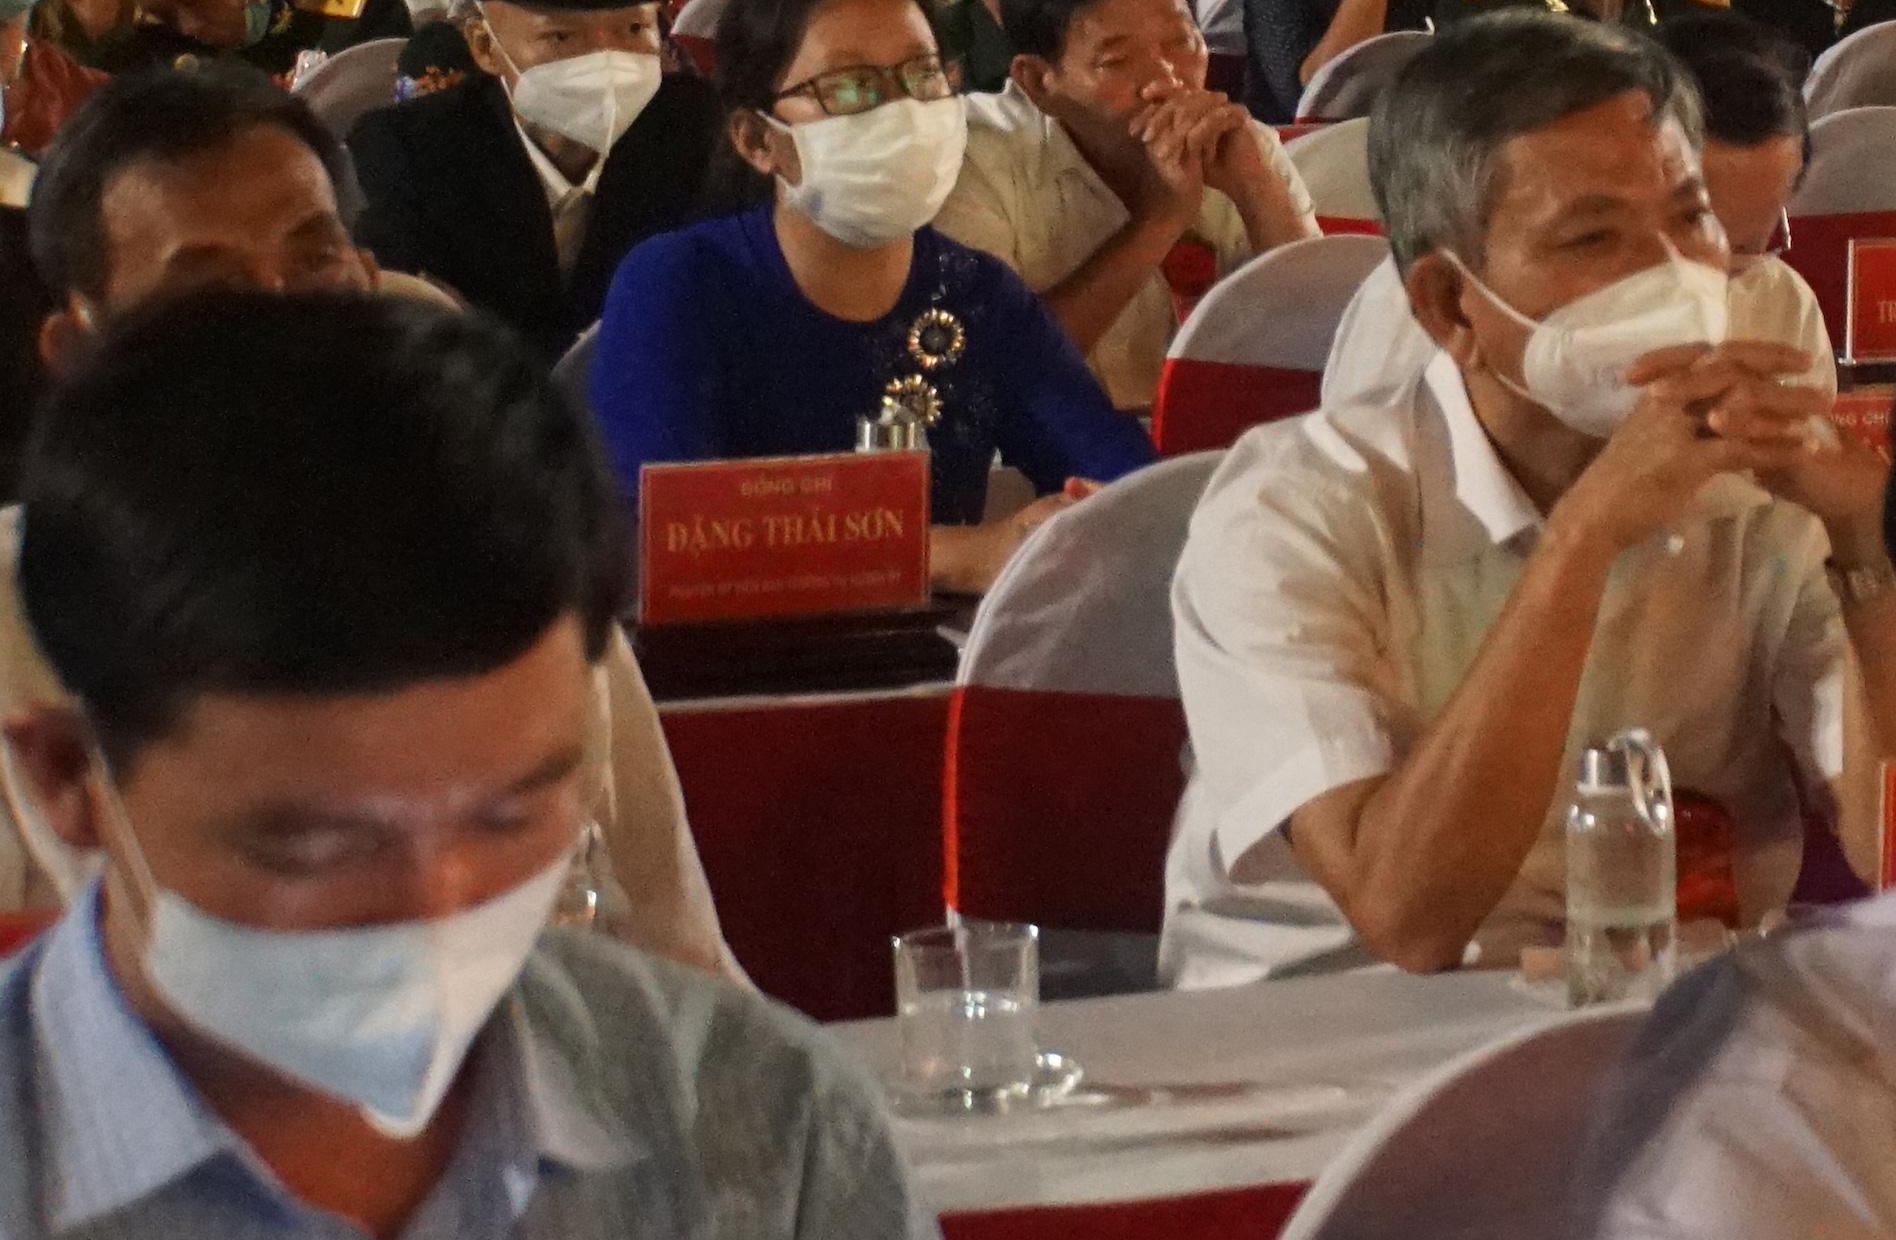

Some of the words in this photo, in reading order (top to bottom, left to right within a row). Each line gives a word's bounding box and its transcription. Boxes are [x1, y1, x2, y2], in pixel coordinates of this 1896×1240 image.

[666, 514, 752, 559] ĐẶNG
[762, 507, 837, 547] THÁI
[844, 507, 904, 541] SƠN
